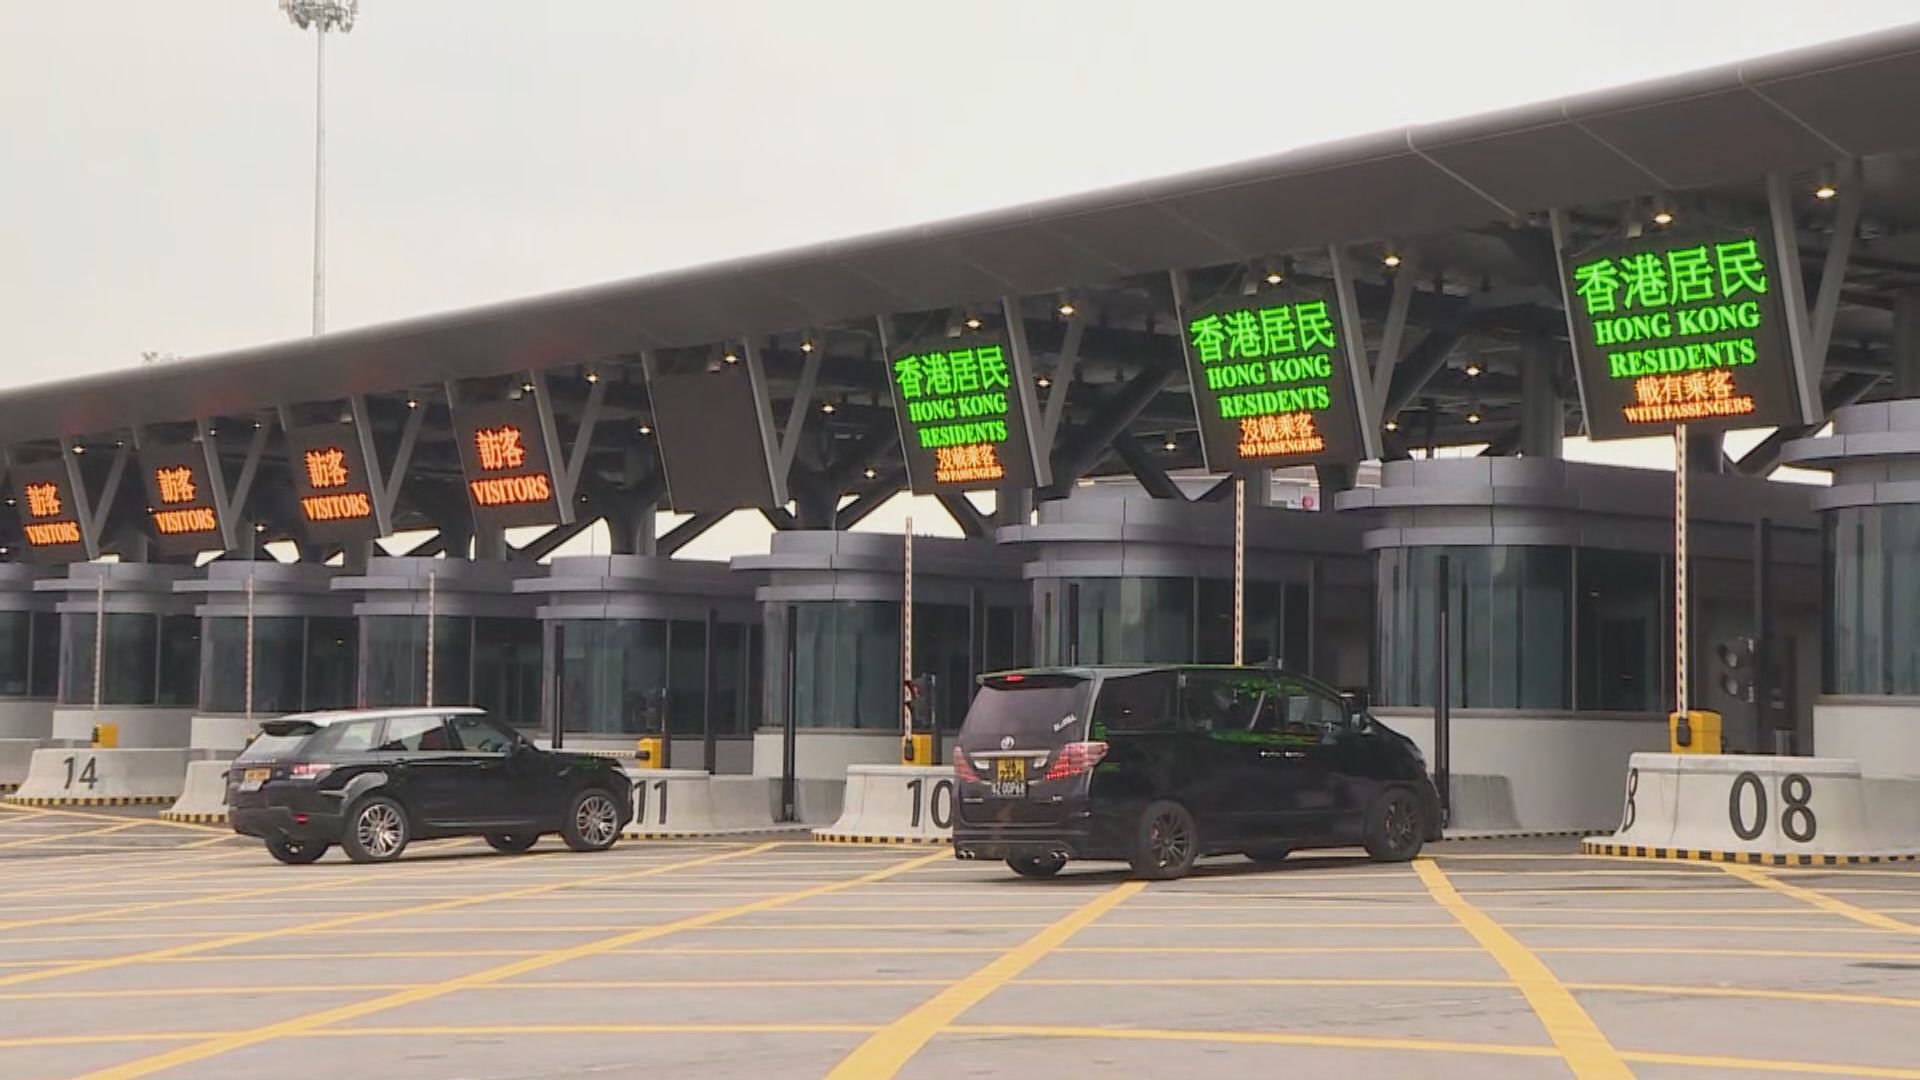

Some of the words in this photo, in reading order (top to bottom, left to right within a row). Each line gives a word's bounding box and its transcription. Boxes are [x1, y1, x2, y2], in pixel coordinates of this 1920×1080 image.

[1575, 240, 1768, 315] 香港居民
[1190, 300, 1336, 364] 香港居民
[1594, 312, 1672, 345] HONG
[1676, 301, 1760, 335] KONG
[894, 345, 1010, 399] 香港居民
[1206, 362, 1265, 389] HONG
[1269, 354, 1331, 382] KONG
[1608, 338, 1757, 377] RESIDENTS
[1218, 386, 1330, 418] RESIDENTS
[1635, 370, 1735, 405] 載有乘客
[908, 398, 955, 422] HONG
[958, 392, 1008, 417] KONG
[1624, 405, 1663, 423] WITH
[1664, 397, 1753, 419] PASSENGERS
[475, 425, 525, 470] 訪客
[918, 420, 1008, 448] RESIDENTS
[1240, 443, 1256, 458] NO
[1257, 437, 1324, 456] PASSENGERS
[156, 466, 197, 503] 訪客
[304, 447, 349, 488] 訪客
[25, 482, 61, 516] 訪客
[303, 493, 370, 520] VISITORS
[470, 474, 550, 506] VISITORS
[24, 521, 80, 546] VISITORS
[154, 508, 216, 534] VISITORS
[63, 756, 98, 790] 14
[634, 780, 667, 825] 11
[906, 778, 953, 829] 10
[1729, 771, 1817, 843] 08
